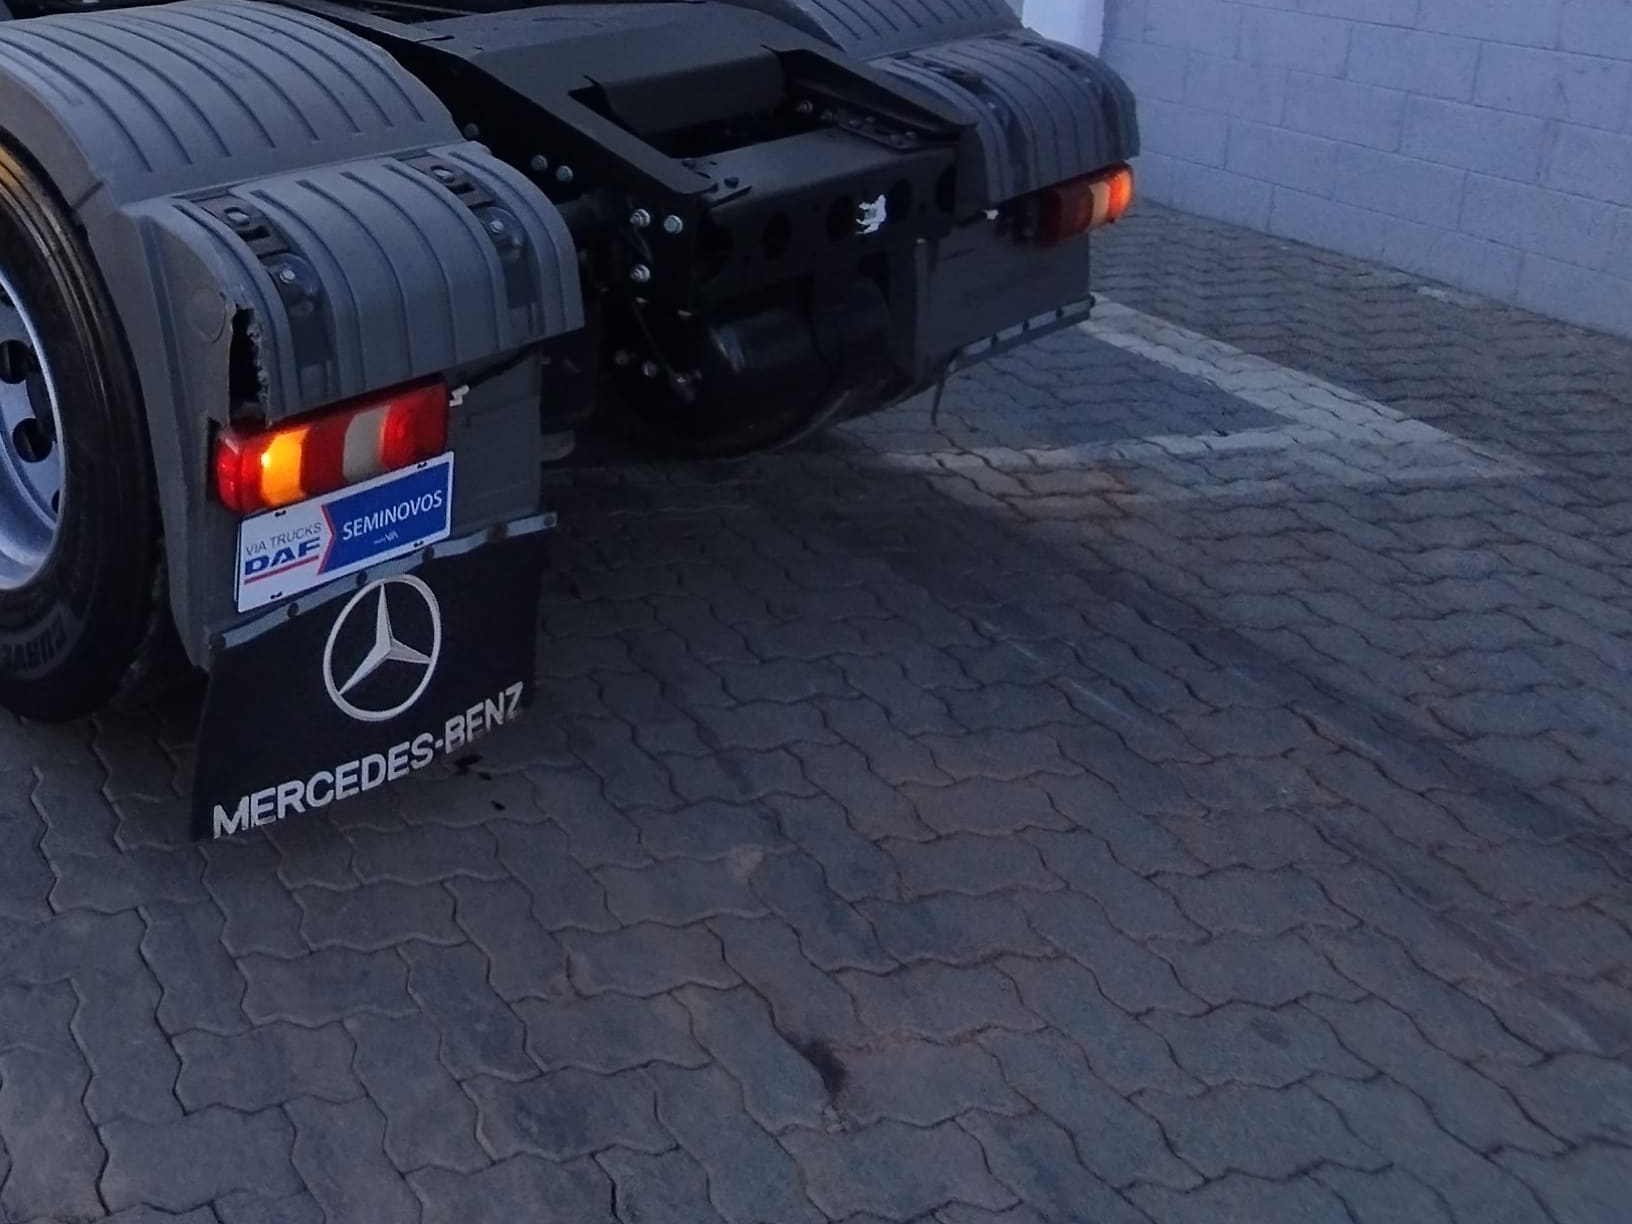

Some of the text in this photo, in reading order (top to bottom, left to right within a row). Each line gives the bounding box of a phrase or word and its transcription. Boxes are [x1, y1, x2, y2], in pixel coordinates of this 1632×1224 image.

[342, 489, 444, 541] SEMINOVOS
[244, 537, 321, 575] DAF
[245, 521, 322, 556] VIA TRUCKS
[212, 681, 524, 840] MERCEDES-BENZ
